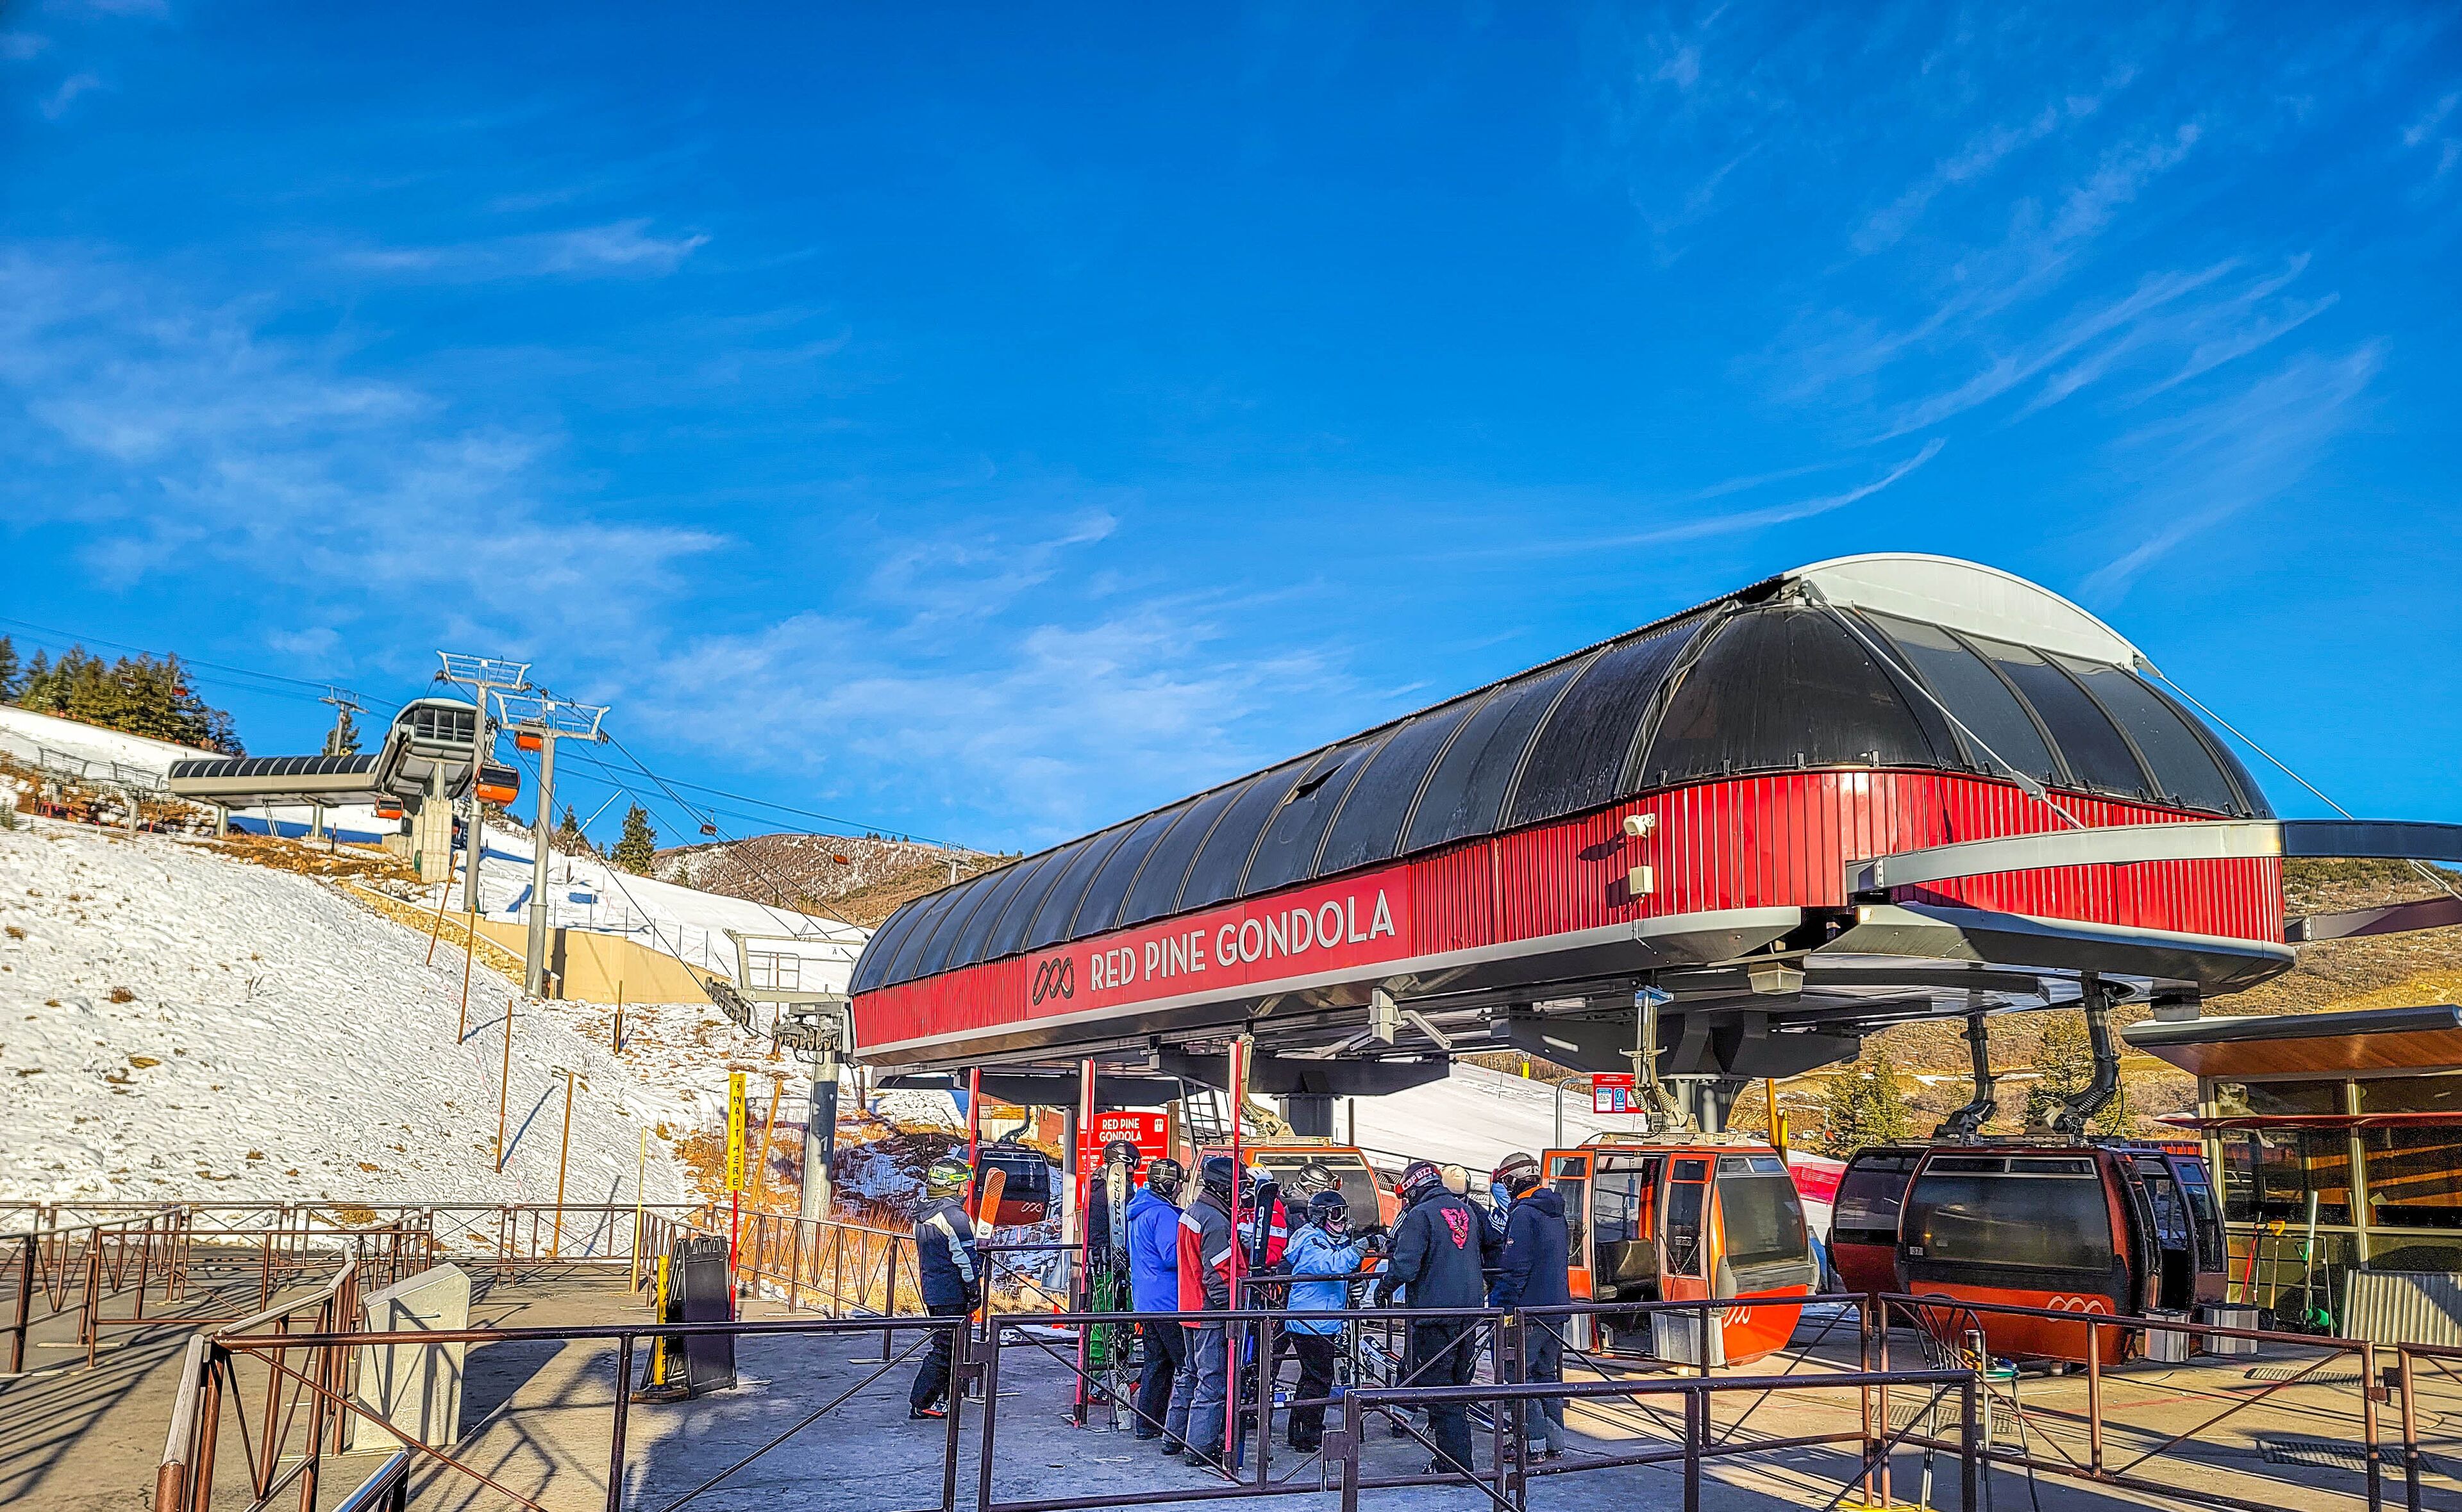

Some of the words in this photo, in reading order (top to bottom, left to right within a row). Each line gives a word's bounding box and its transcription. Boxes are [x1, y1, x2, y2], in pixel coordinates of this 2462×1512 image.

[1091, 947, 1135, 991] RED
[1144, 929, 1205, 981] PINE
[1216, 888, 1396, 967] GONDOLA
[733, 1096, 741, 1137] WAIT
[1099, 1130, 1143, 1142] GONDOLA
[1102, 1118, 1119, 1130] RED
[1120, 1118, 1140, 1129] PINE
[1255, 1206, 1265, 1249] HEAD
